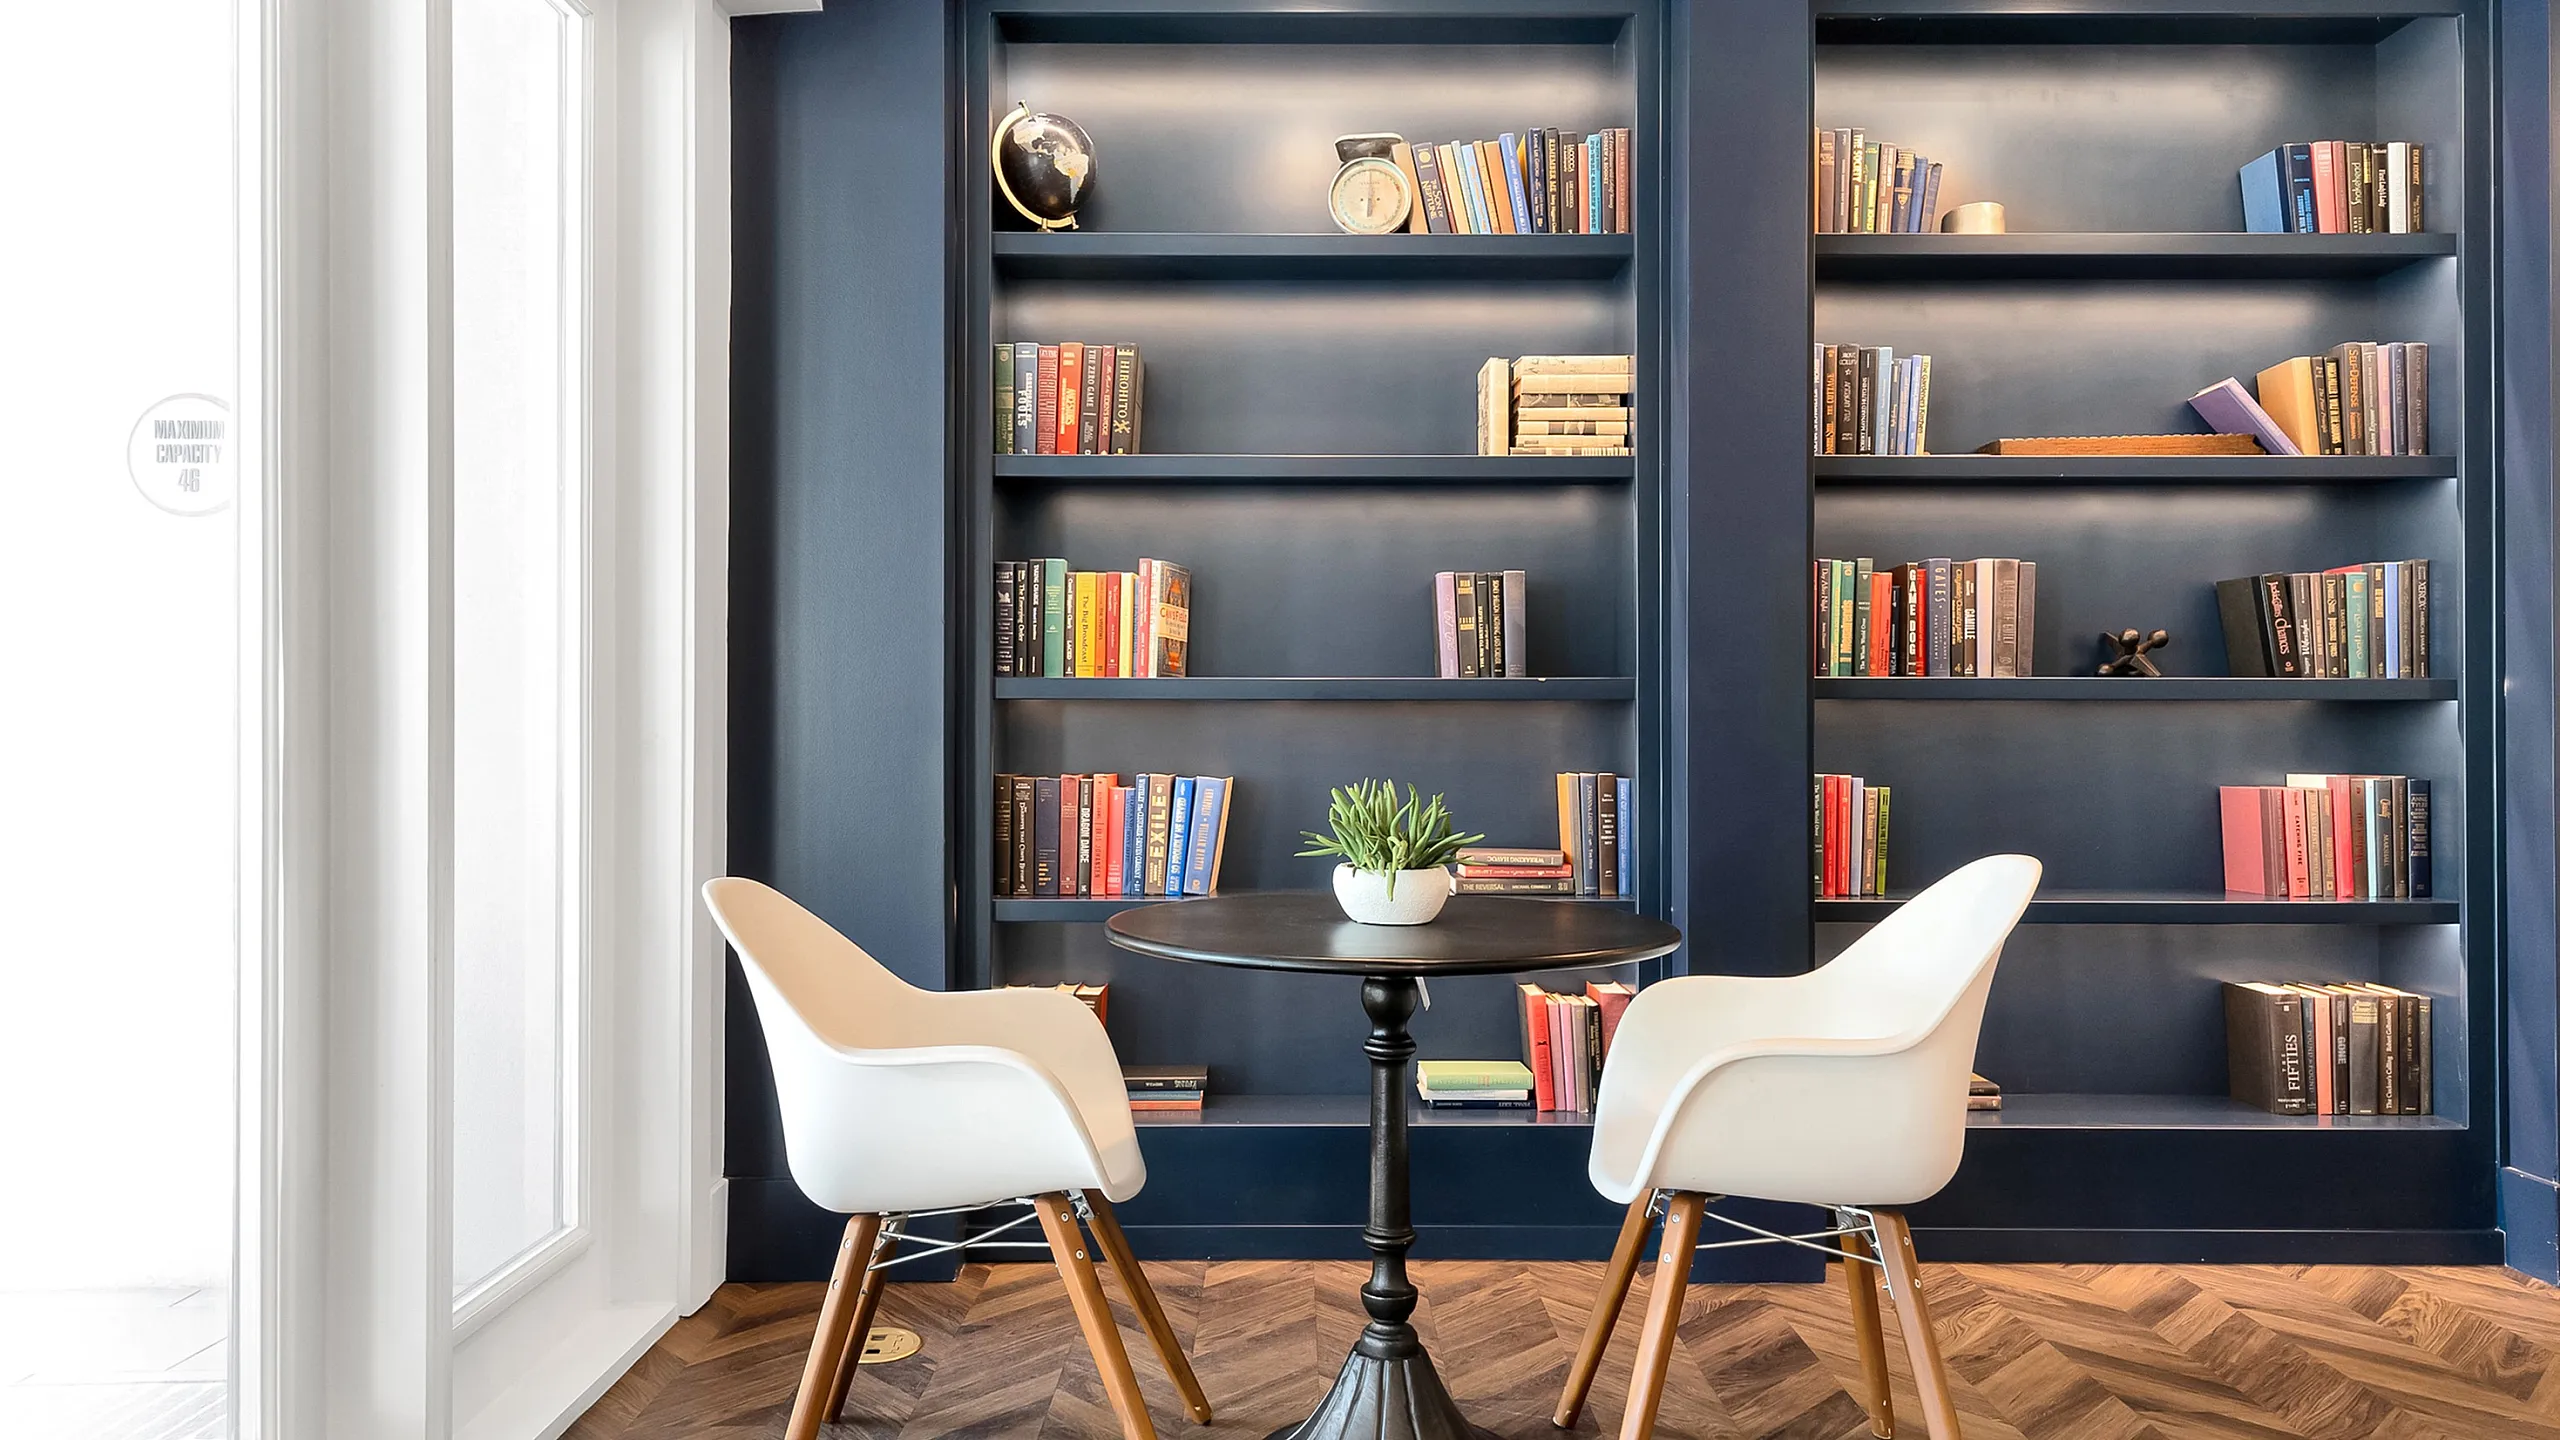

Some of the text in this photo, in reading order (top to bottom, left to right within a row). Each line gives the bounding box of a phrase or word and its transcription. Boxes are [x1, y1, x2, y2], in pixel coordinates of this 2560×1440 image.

[1549, 138, 1557, 179] REMEMBER
[1567, 144, 1575, 173] IACOCCA
[1852, 134, 1864, 183] THE SOCIETY
[1421, 181, 1437, 220] NEPTUNE
[1433, 190, 1444, 210] SON
[1549, 180, 1557, 192] ME
[1086, 349, 1097, 407] THE ZERO GAME
[1117, 360, 1130, 419] HIROHITO
[1826, 373, 1834, 404] COTTAGE
[2349, 350, 2360, 408] SELF-DEFENSE
[1017, 390, 1028, 427] FOOLS
[154, 420, 225, 439] MAXIMUM
[156, 444, 222, 463] CAPACITY
[177, 468, 201, 492] 46
[1821, 568, 1829, 579] Day
[1935, 567, 1946, 602] GATES
[1017, 596, 1025, 623] Emerging
[1821, 595, 1829, 612] Night
[1909, 569, 1917, 655] GAME DOG
[1965, 608, 1975, 640] CAMILLE
[2275, 617, 2291, 655] Chances
[1080, 807, 1091, 838] DRAGON
[1149, 795, 1167, 858] EXILE
[1080, 839, 1090, 864] DANCE
[1172, 865, 1181, 874] SO
[2285, 1034, 2301, 1091] FIFTIES
[2337, 1036, 2347, 1064] GONE
